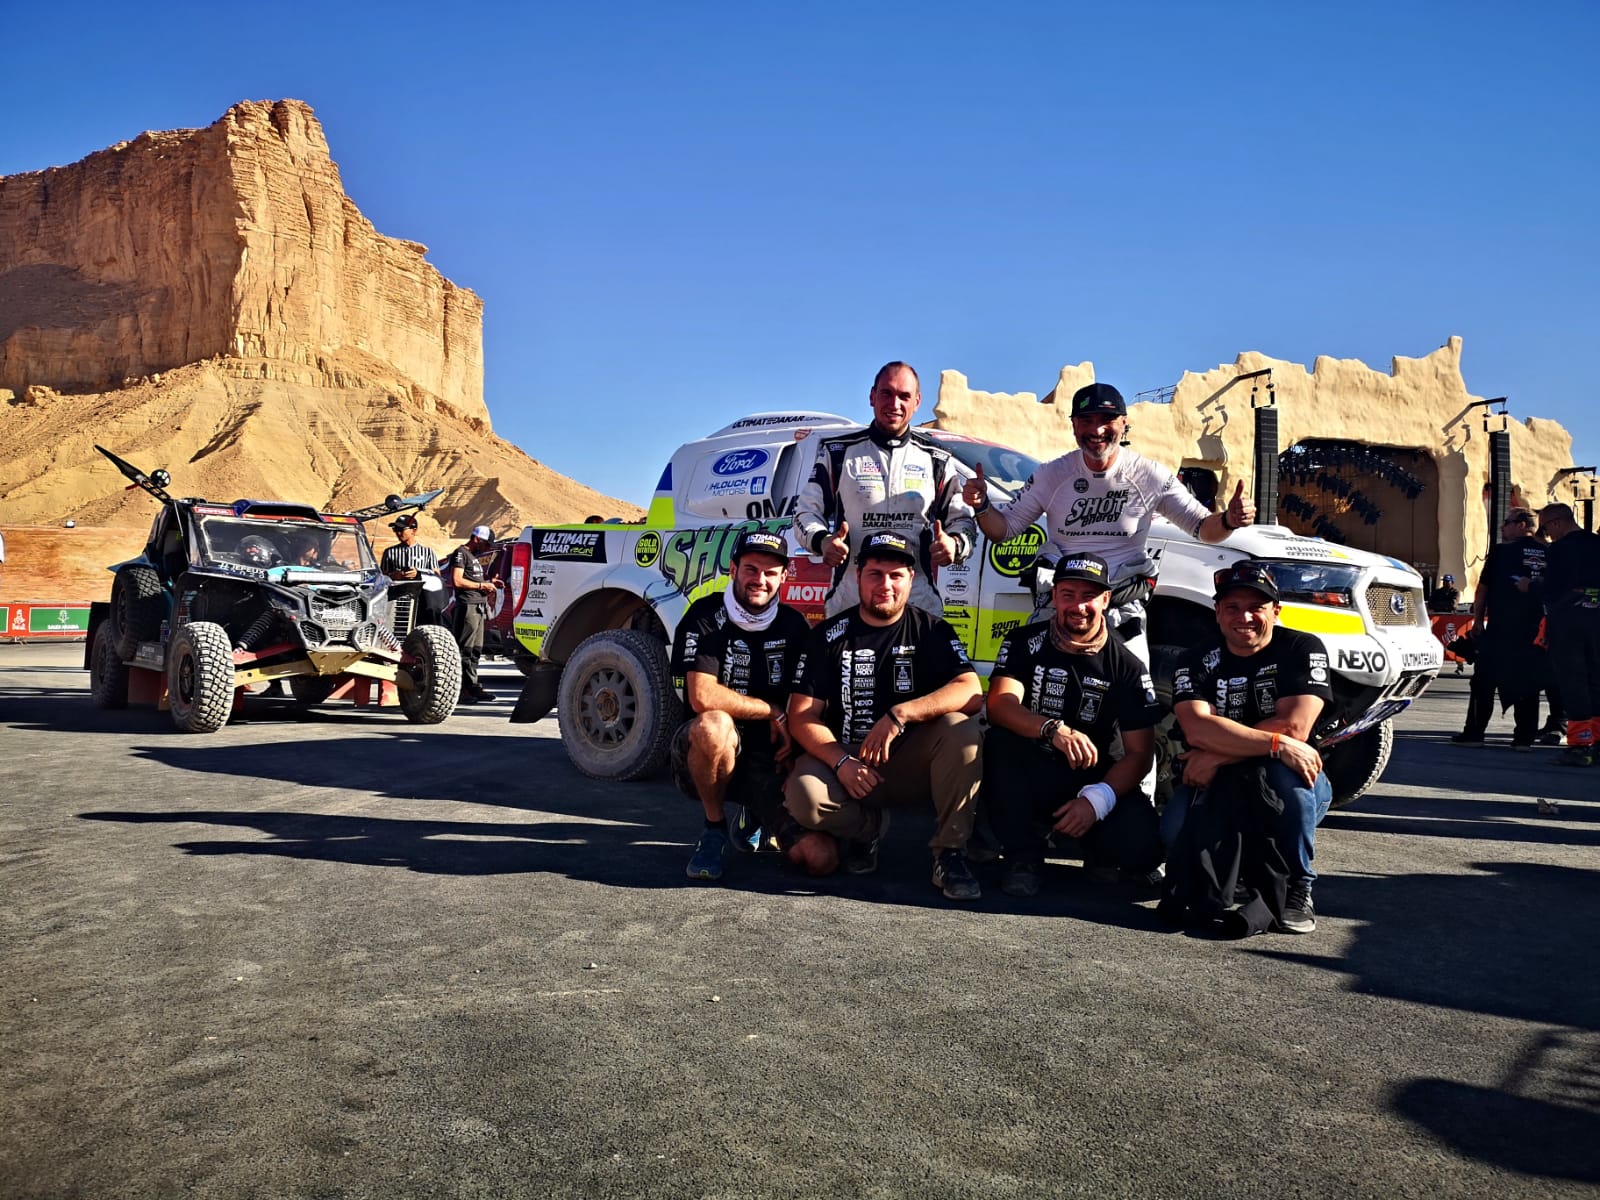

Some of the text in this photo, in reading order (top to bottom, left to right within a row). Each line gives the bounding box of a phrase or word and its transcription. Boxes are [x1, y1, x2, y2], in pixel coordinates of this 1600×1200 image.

[718, 452, 757, 473] Ford
[1106, 489, 1129, 498] ONE
[862, 512, 915, 521] ULTIMATE
[1064, 497, 1128, 527] SHOT
[542, 532, 600, 546] ULTIMATE
[540, 544, 570, 554] DAKAR
[996, 545, 1038, 556] NUTRITION
[1338, 649, 1386, 673] NEXO
